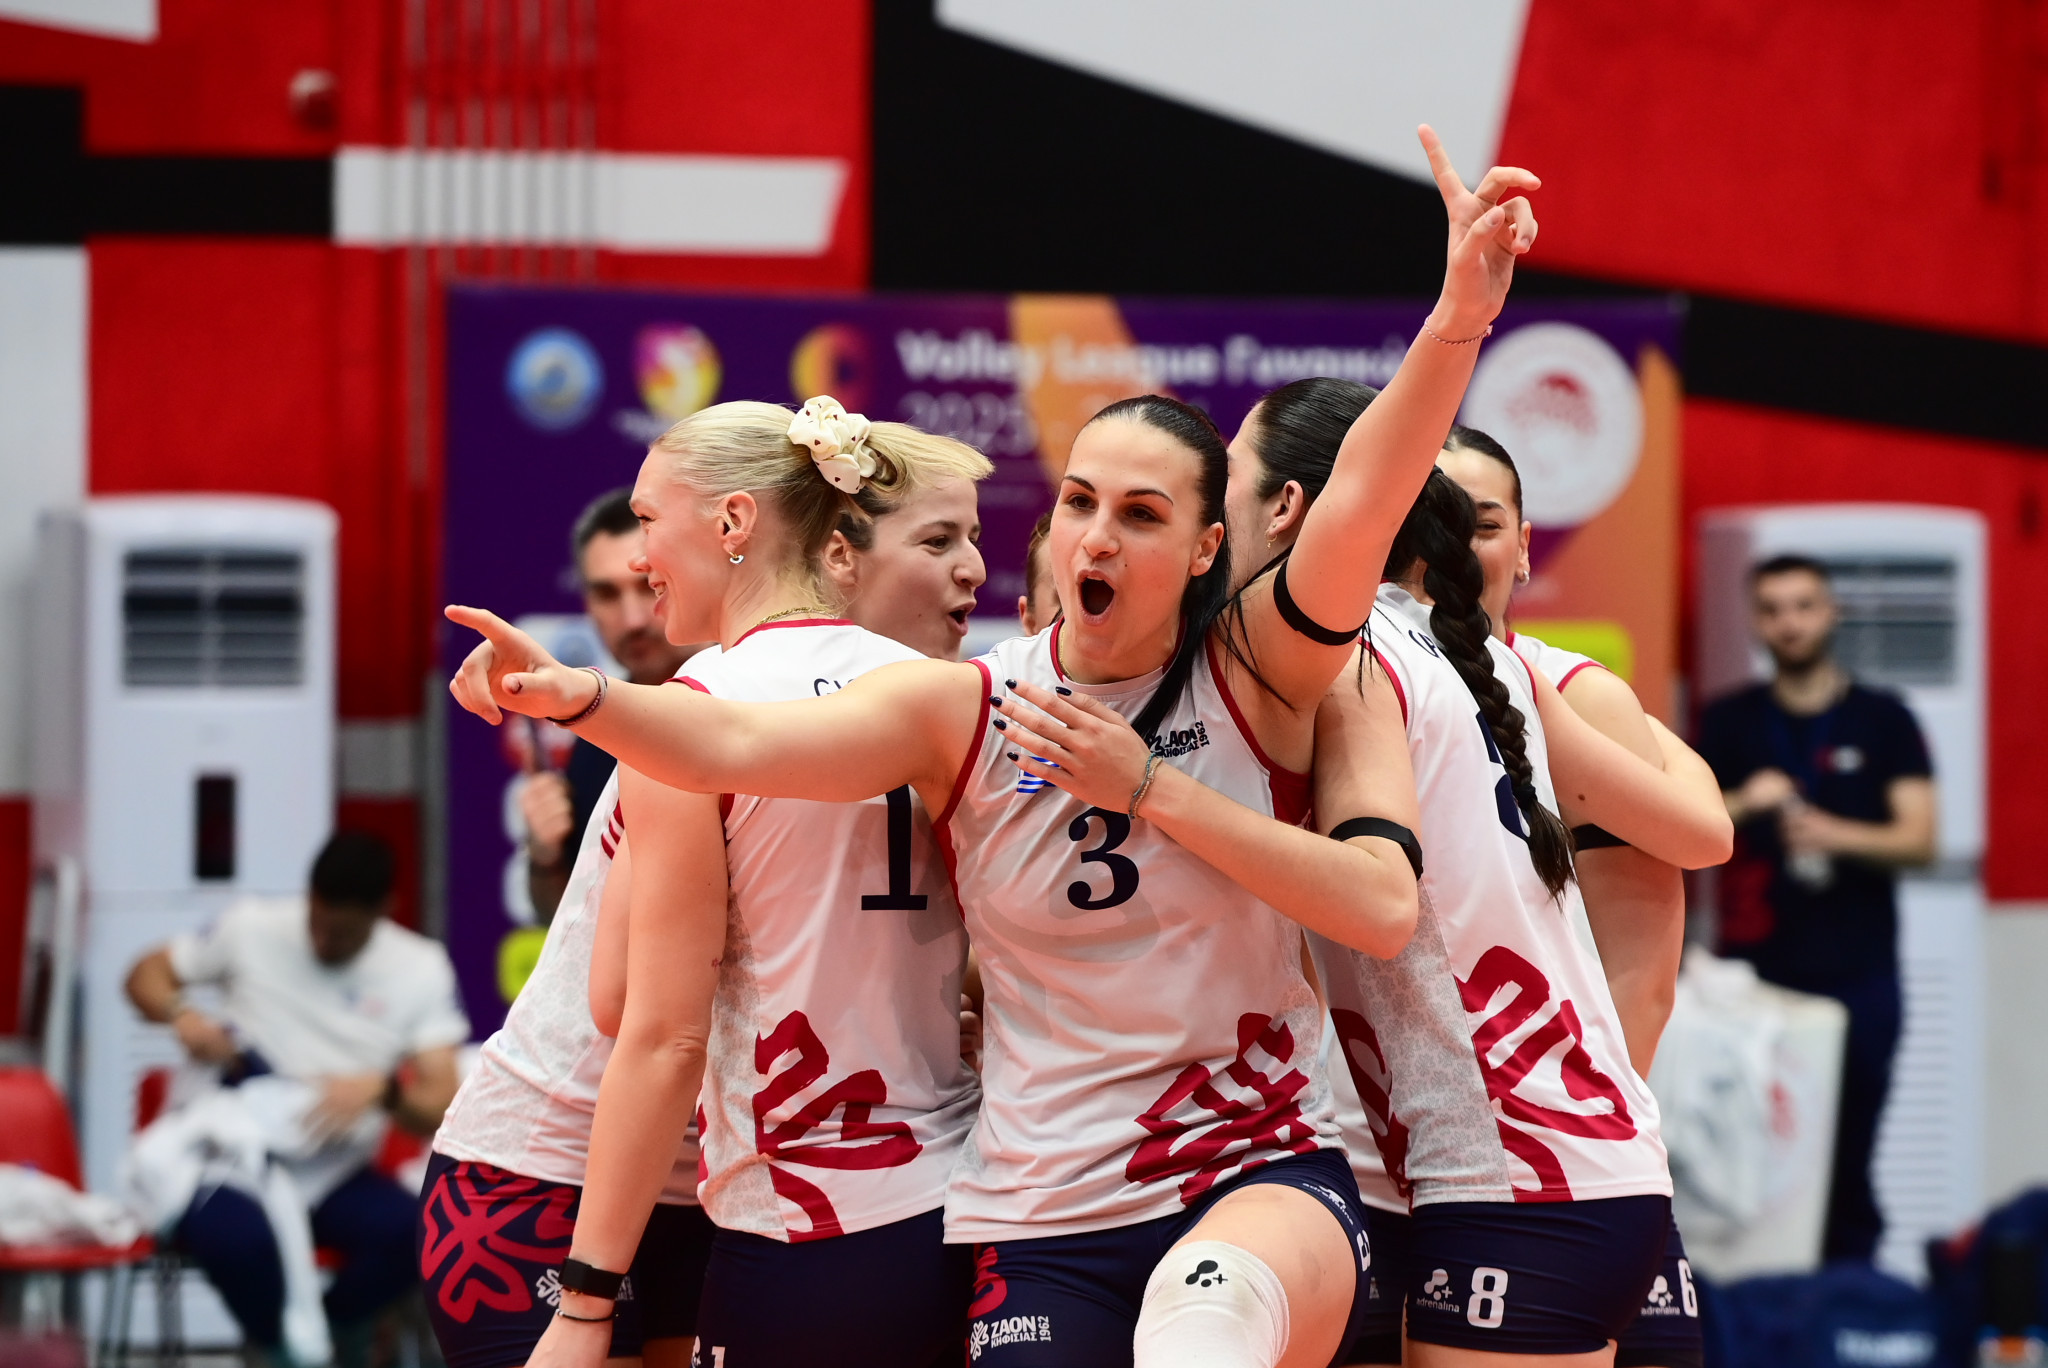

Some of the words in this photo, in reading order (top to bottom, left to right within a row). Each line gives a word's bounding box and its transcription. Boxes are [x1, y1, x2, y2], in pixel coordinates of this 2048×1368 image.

[897, 331, 1043, 392] Volley
[1054, 335, 1218, 390] League
[1194, 720, 1210, 748] 1962
[861, 784, 928, 910] 1
[1066, 806, 1139, 911] 3
[1416, 1297, 1460, 1313] adrenalina
[1466, 1266, 1509, 1329] 8
[1677, 1258, 1698, 1318] 6
[1037, 1315, 1051, 1342] 1962
[1640, 1306, 1681, 1316] adrenalina
[990, 1331, 1037, 1349] ΚΗΦΙΣΙΑΣ
